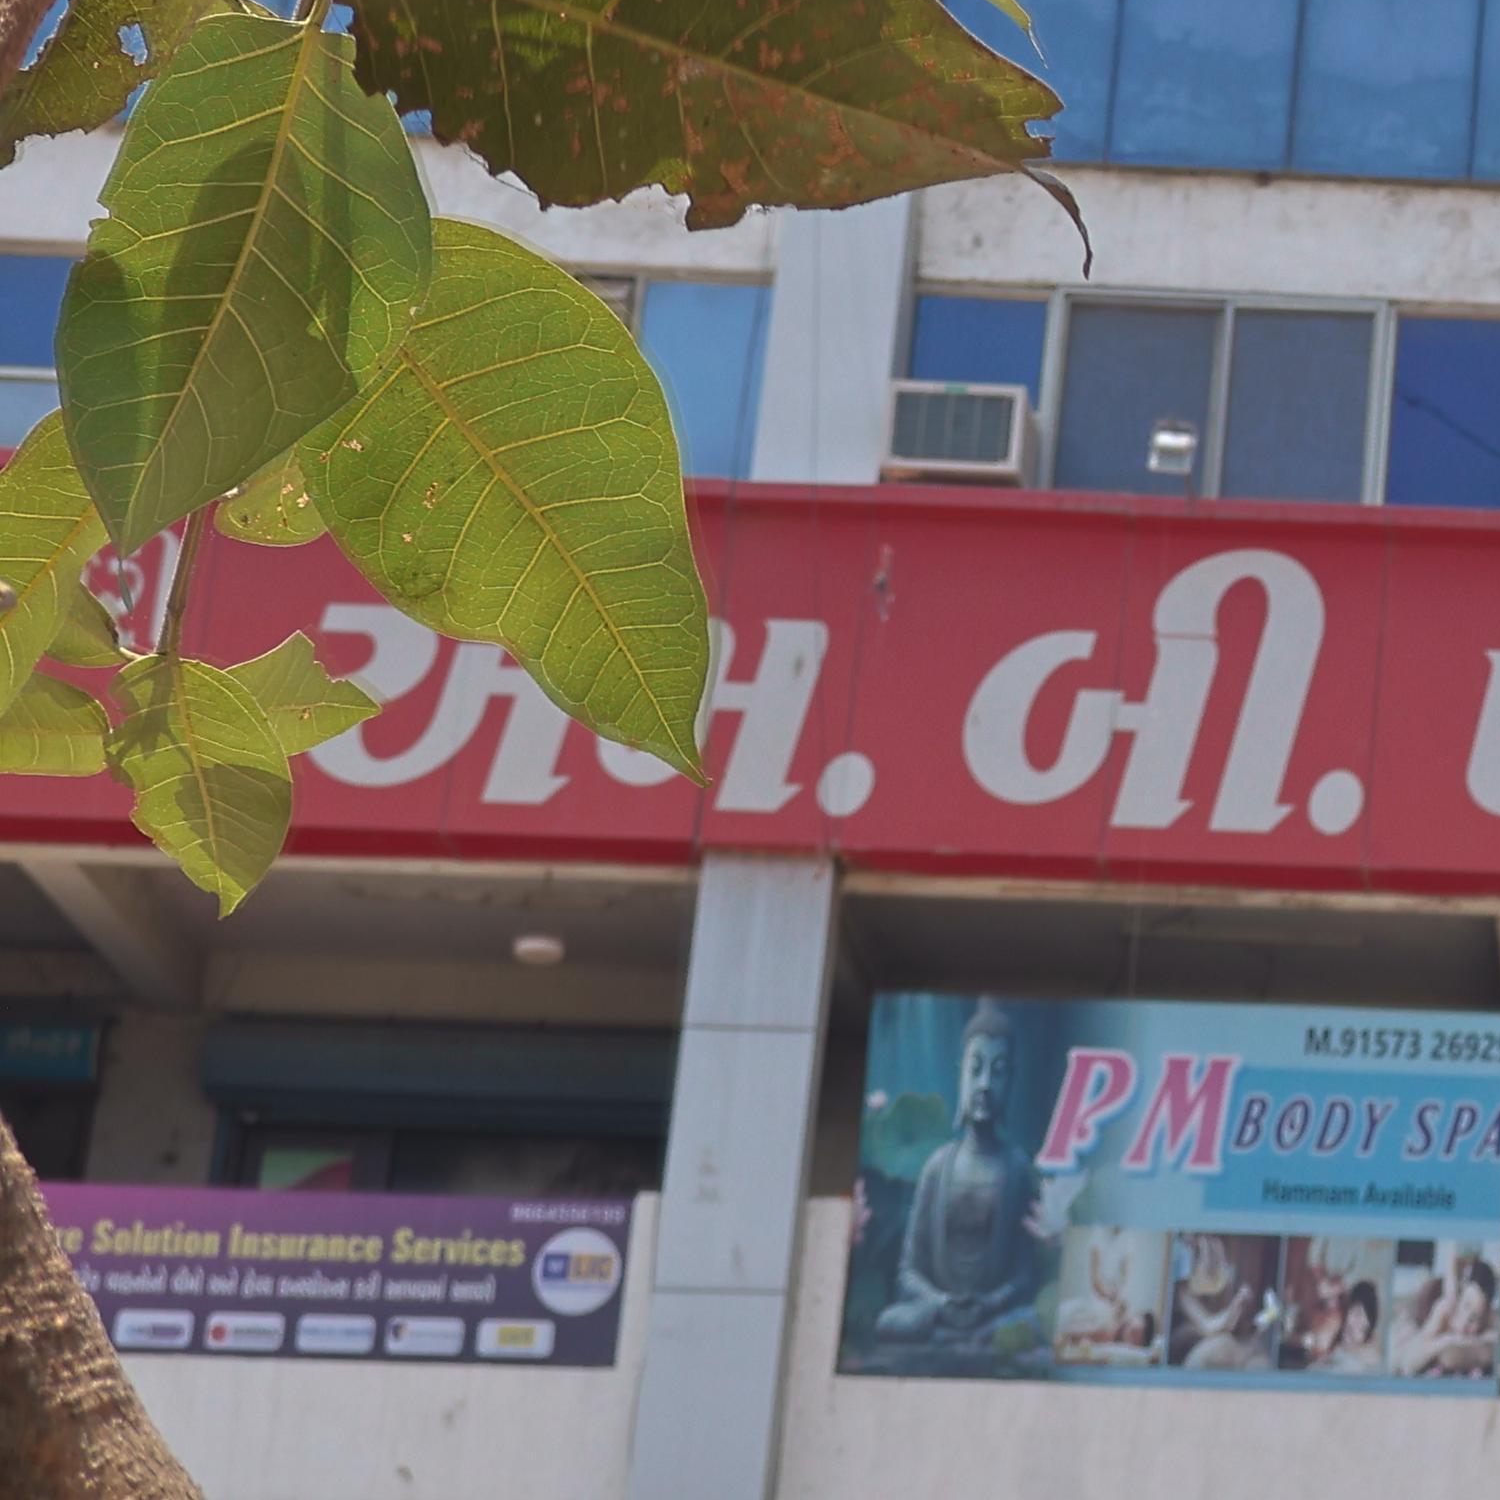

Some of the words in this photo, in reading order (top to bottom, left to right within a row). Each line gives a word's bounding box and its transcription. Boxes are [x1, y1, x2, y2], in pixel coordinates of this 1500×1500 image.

[963, 548, 1366, 836] બી.
[1303, 1026, 1421, 1059] M.91573
[1231, 1096, 1394, 1155] BODY
[1261, 1179, 1358, 1205] Hammam
[1363, 1181, 1457, 1209] Available
[91, 1218, 221, 1259] Solution
[227, 1222, 384, 1264] Insurance
[390, 1225, 527, 1269] Services
